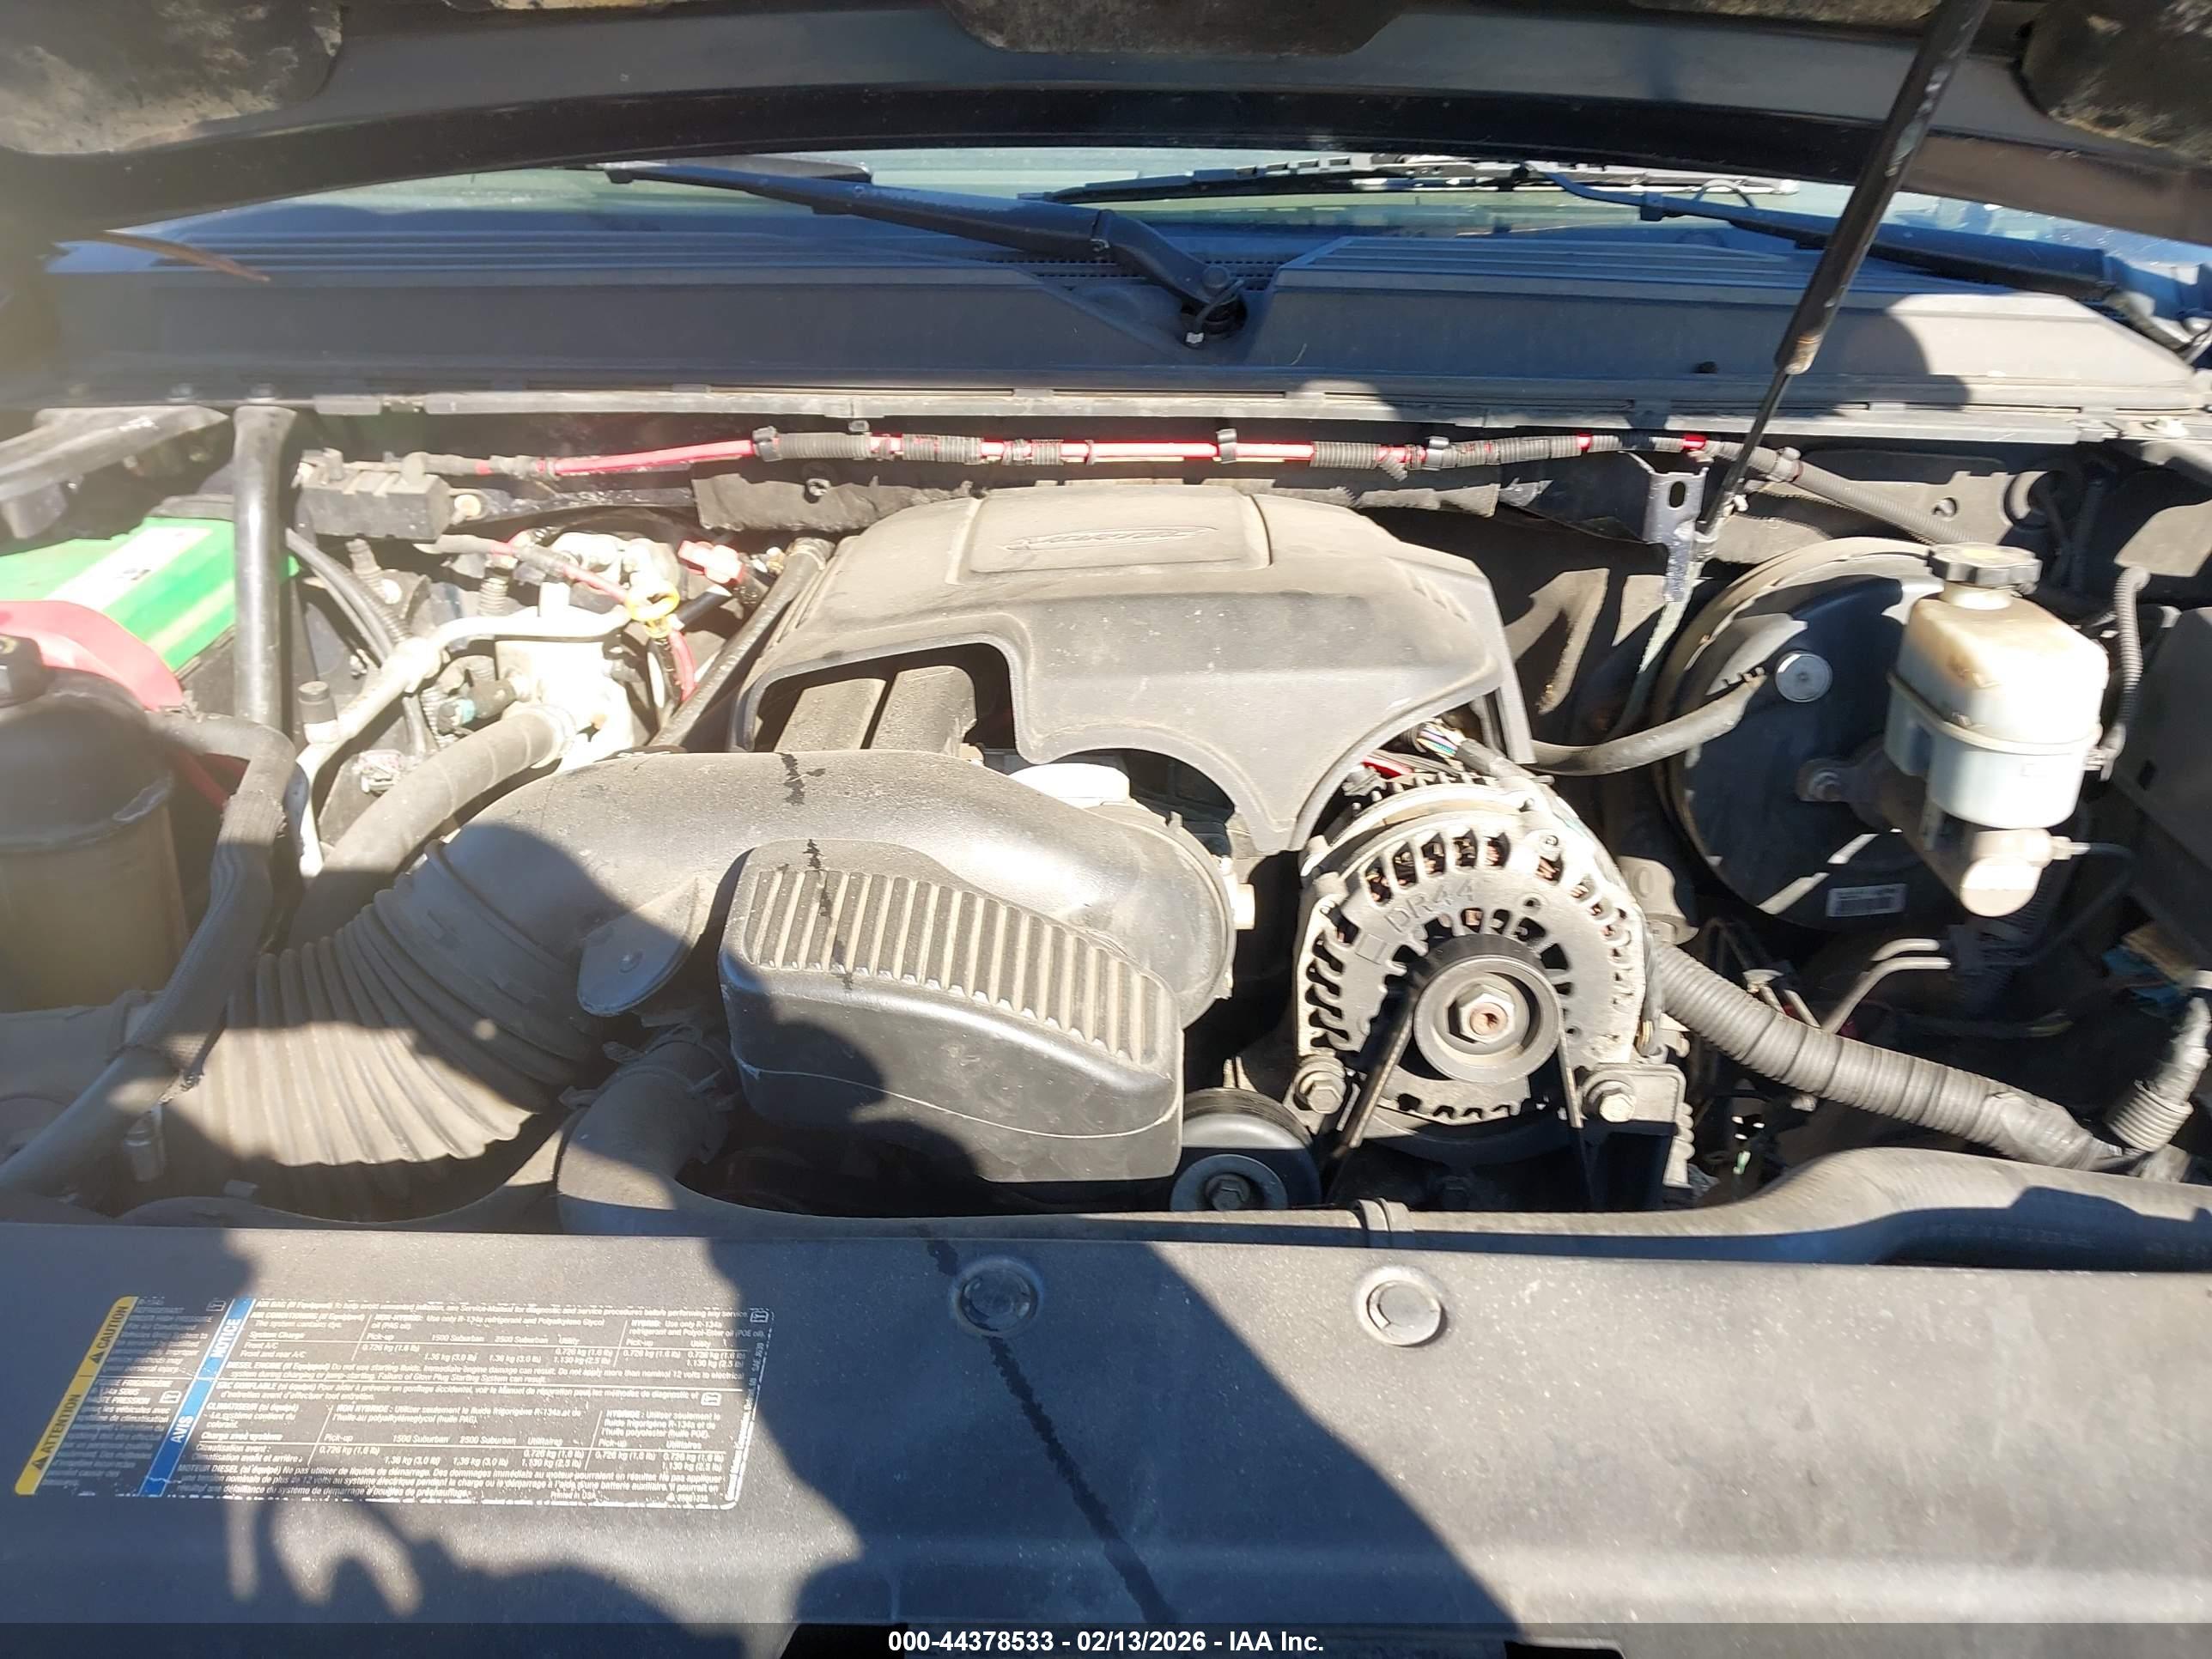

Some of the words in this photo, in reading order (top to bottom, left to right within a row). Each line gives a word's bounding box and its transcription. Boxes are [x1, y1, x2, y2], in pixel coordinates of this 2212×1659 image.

[97, 1305, 129, 1350] CAUTION
[210, 1318, 243, 1358] NOTICE
[247, 1331, 277, 1340] System
[367, 1333, 395, 1342] Pick-up
[449, 1334, 485, 1343] Suburban
[513, 1336, 549, 1345] Suburban
[626, 1338, 653, 1347] Pick-up
[243, 1341, 265, 1350] Front
[240, 1349, 261, 1358] Front
[46, 1394, 82, 1454] ATTENTION
[169, 1415, 195, 1443] AVIS
[324, 1433, 354, 1443] Pick-up
[392, 1435, 413, 1443] 1500
[412, 1435, 450, 1444] Suburban
[479, 1437, 517, 1446] Suburban
[598, 1438, 628, 1448] Pick-up
[210, 1464, 240, 1474] DIESEL
[309, 1468, 339, 1476] utiliser
[348, 1468, 377, 1478] liquide
[224, 1474, 261, 1483] nominale
[456, 1479, 484, 1489] charge
